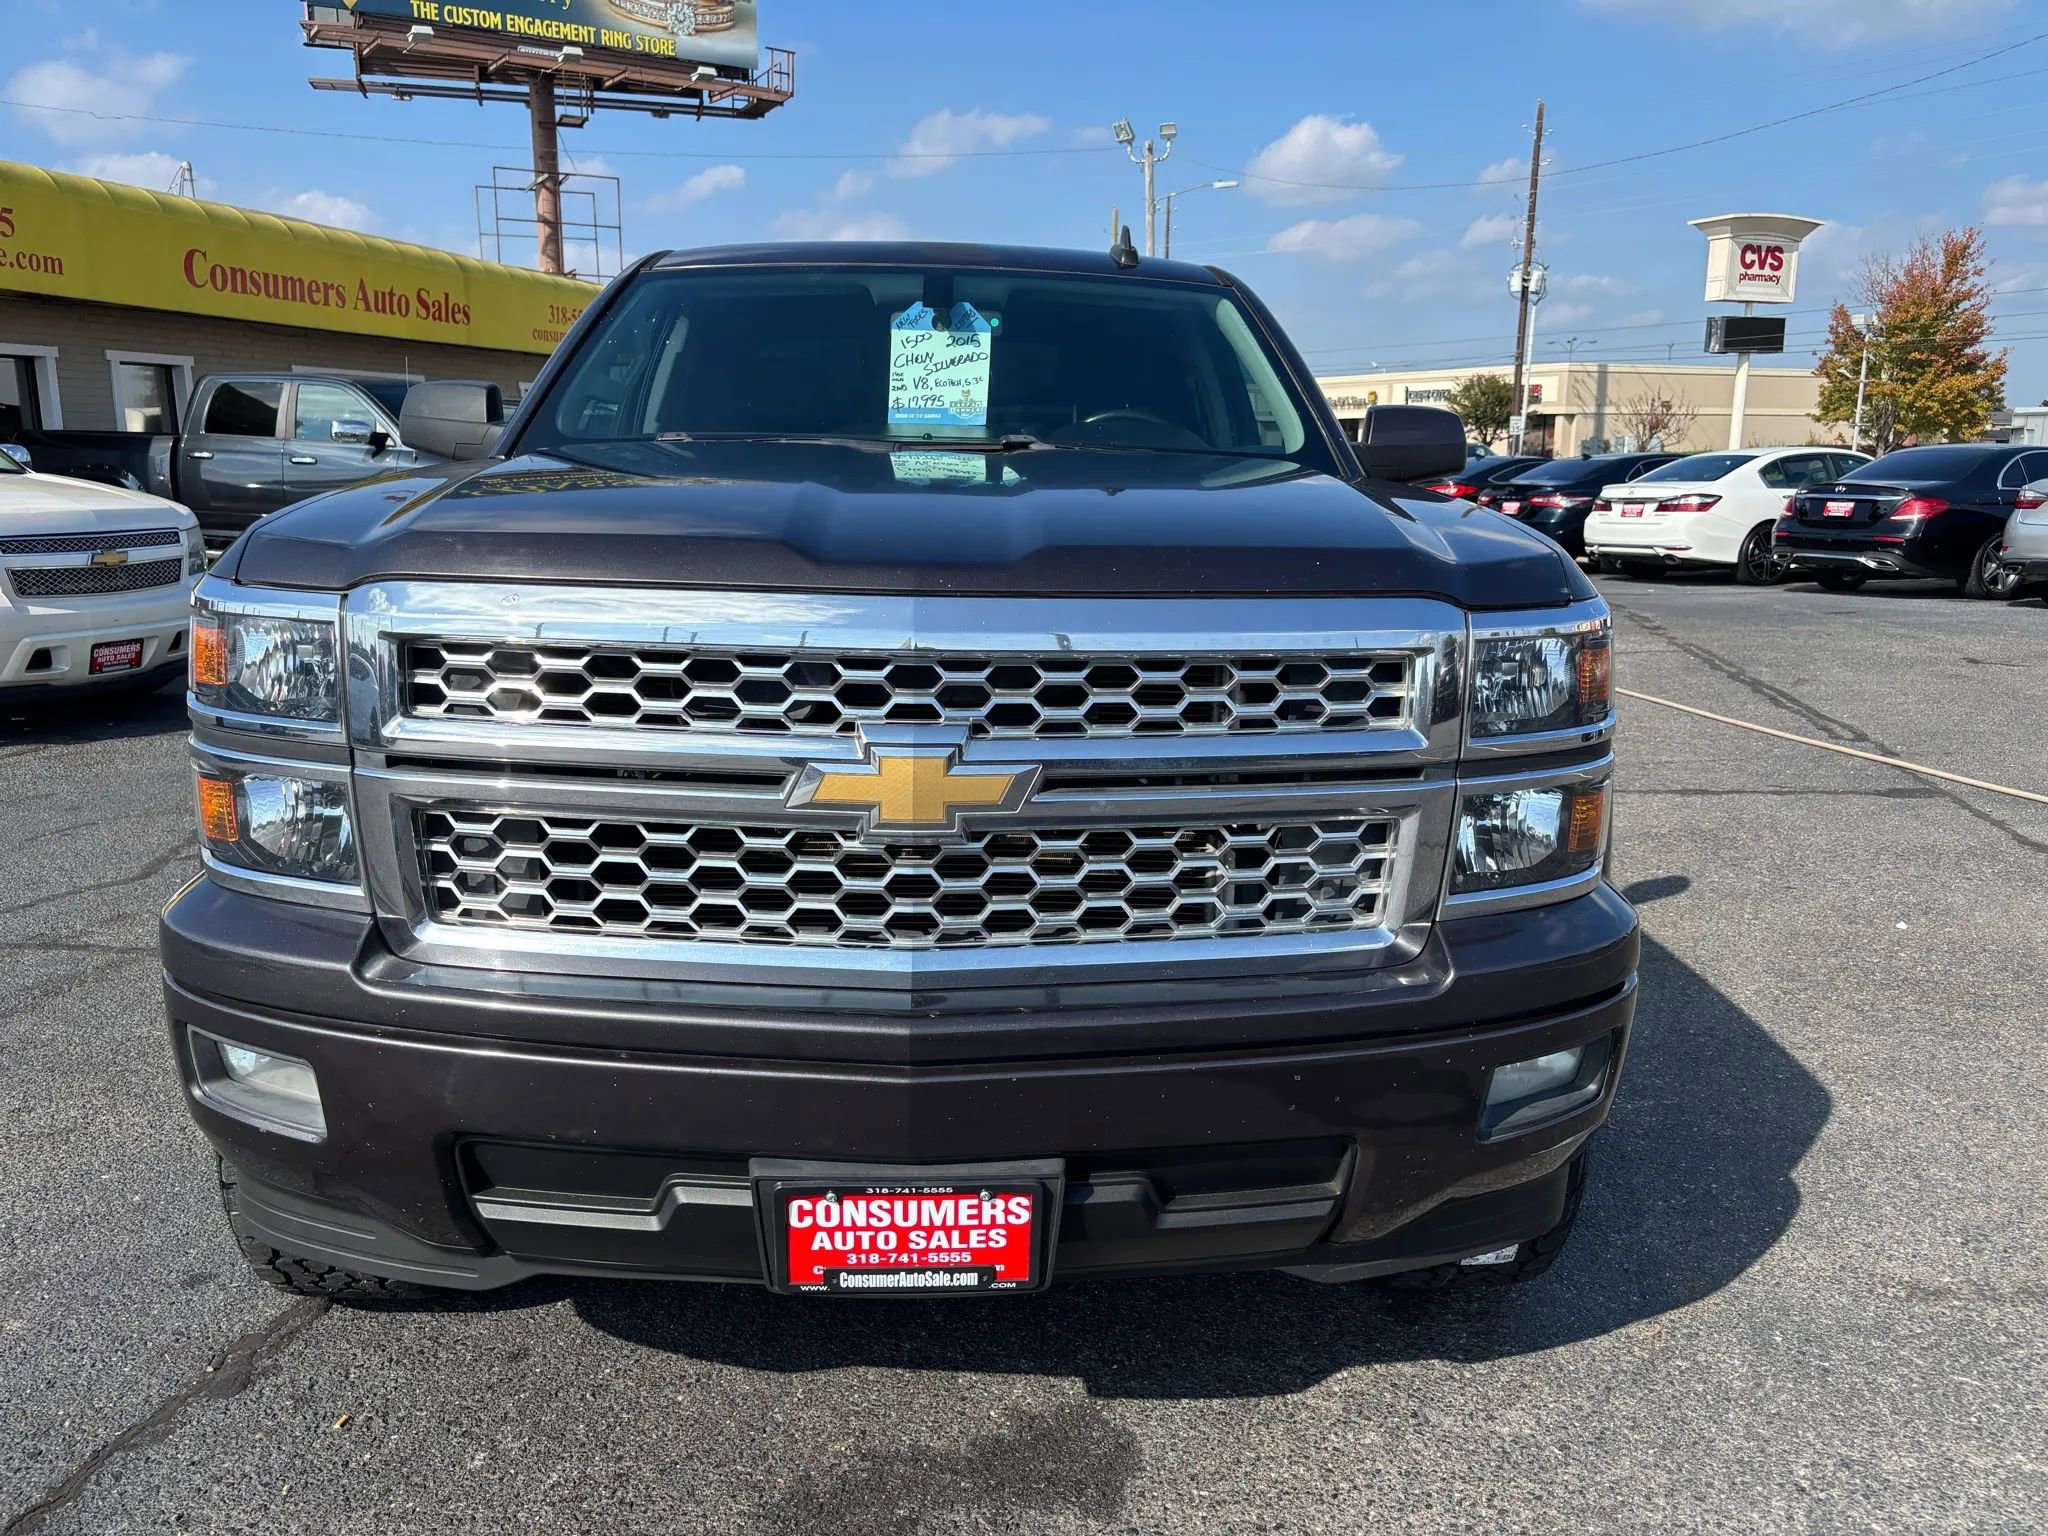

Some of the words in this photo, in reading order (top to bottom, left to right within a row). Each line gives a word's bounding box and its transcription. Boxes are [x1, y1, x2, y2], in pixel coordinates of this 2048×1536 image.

[410, 0, 440, 21] THE
[443, 6, 502, 29] CUSTOM
[506, 15, 596, 44] ENGAGEMENT
[601, 31, 632, 49] RING
[636, 36, 677, 56] STORE
[1740, 243, 1784, 272] CVS
[1738, 271, 1781, 285] pharmacy
[184, 248, 346, 309] Consumers
[353, 277, 410, 318] Auto
[416, 287, 471, 326] Sales
[901, 332, 932, 349] 1500
[945, 333, 981, 349] 2015
[894, 352, 934, 368] CHEVY
[923, 352, 988, 376] SILVERADO
[93, 643, 141, 657] CONSUMERS
[97, 655, 115, 663] AUTO
[116, 652, 136, 660] SALES
[789, 1197, 1030, 1228] CONSUMERS
[811, 1230, 898, 1250] AUTO
[908, 1229, 1007, 1249] SALES
[846, 1252, 972, 1264] 318-741-5555
[839, 1271, 979, 1288] ConsumerAutoSale.com
